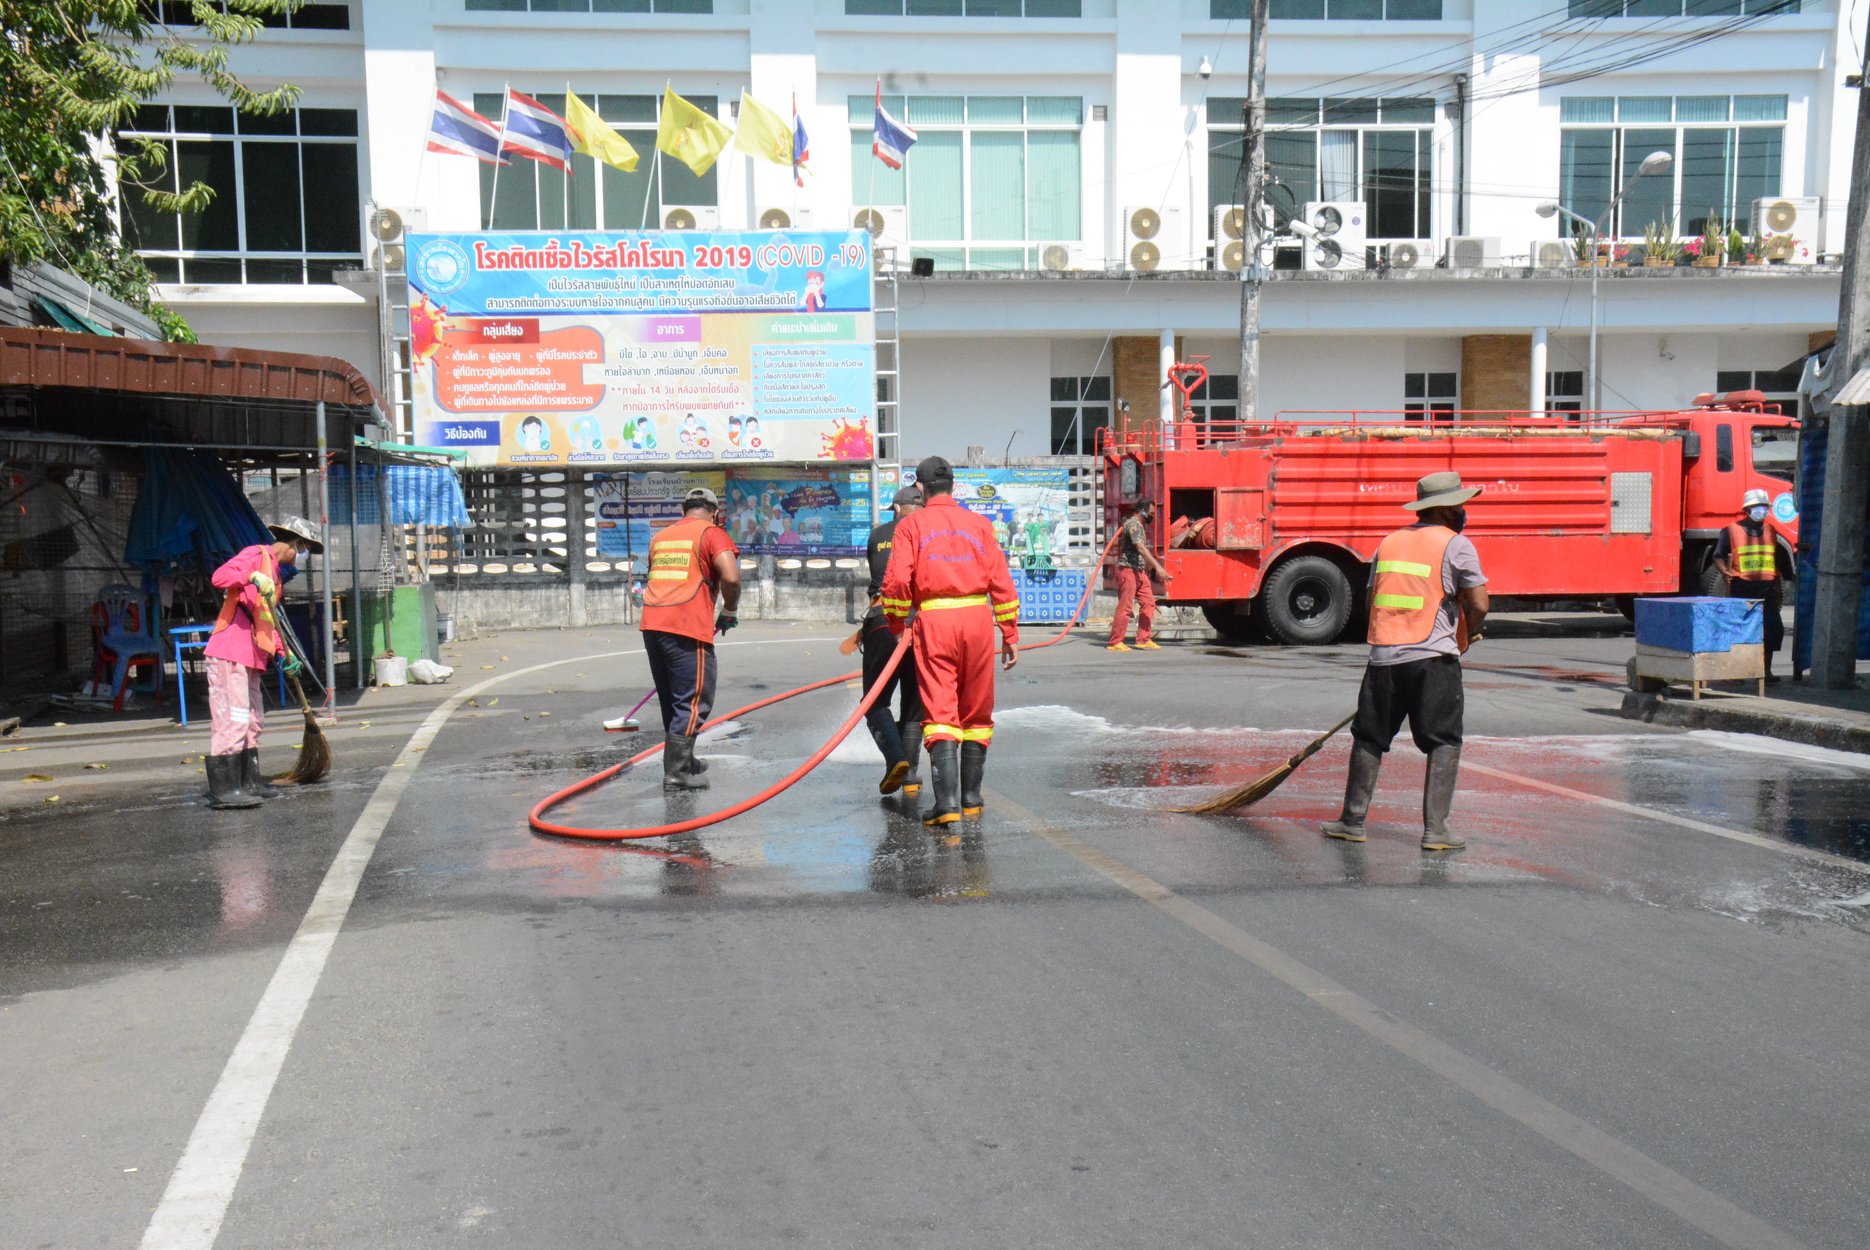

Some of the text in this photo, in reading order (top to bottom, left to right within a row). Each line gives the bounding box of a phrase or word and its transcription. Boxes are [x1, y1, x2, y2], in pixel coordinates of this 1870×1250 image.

[474, 240, 866, 270] โรคติดเชื้อไวรัสโคโรนา 2019 (COVID -19)
[548, 276, 735, 292] เป็นไวรัสสายพันธุ์ใหม่ เป็นสาเหตุให้ปอดอักเสบ
[487, 292, 796, 310] สามารถติดต่อทางระบบหายใจจากคนสู่คน มีความรุนแรงถึงขั้นอาจเสียชีวิตได้
[483, 322, 524, 339] กลุ่มเสี่ยง
[657, 324, 685, 335] อาการ
[452, 348, 598, 363] เด็กเล็ก ผู้สูงอายุ ผู้ที่มีโรคประจำตัว
[604, 365, 651, 377] หายใจลำบาก
[650, 385, 661, 395] 14
[663, 383, 675, 395] วัน
[444, 425, 487, 440] วิธีป้องกัน
